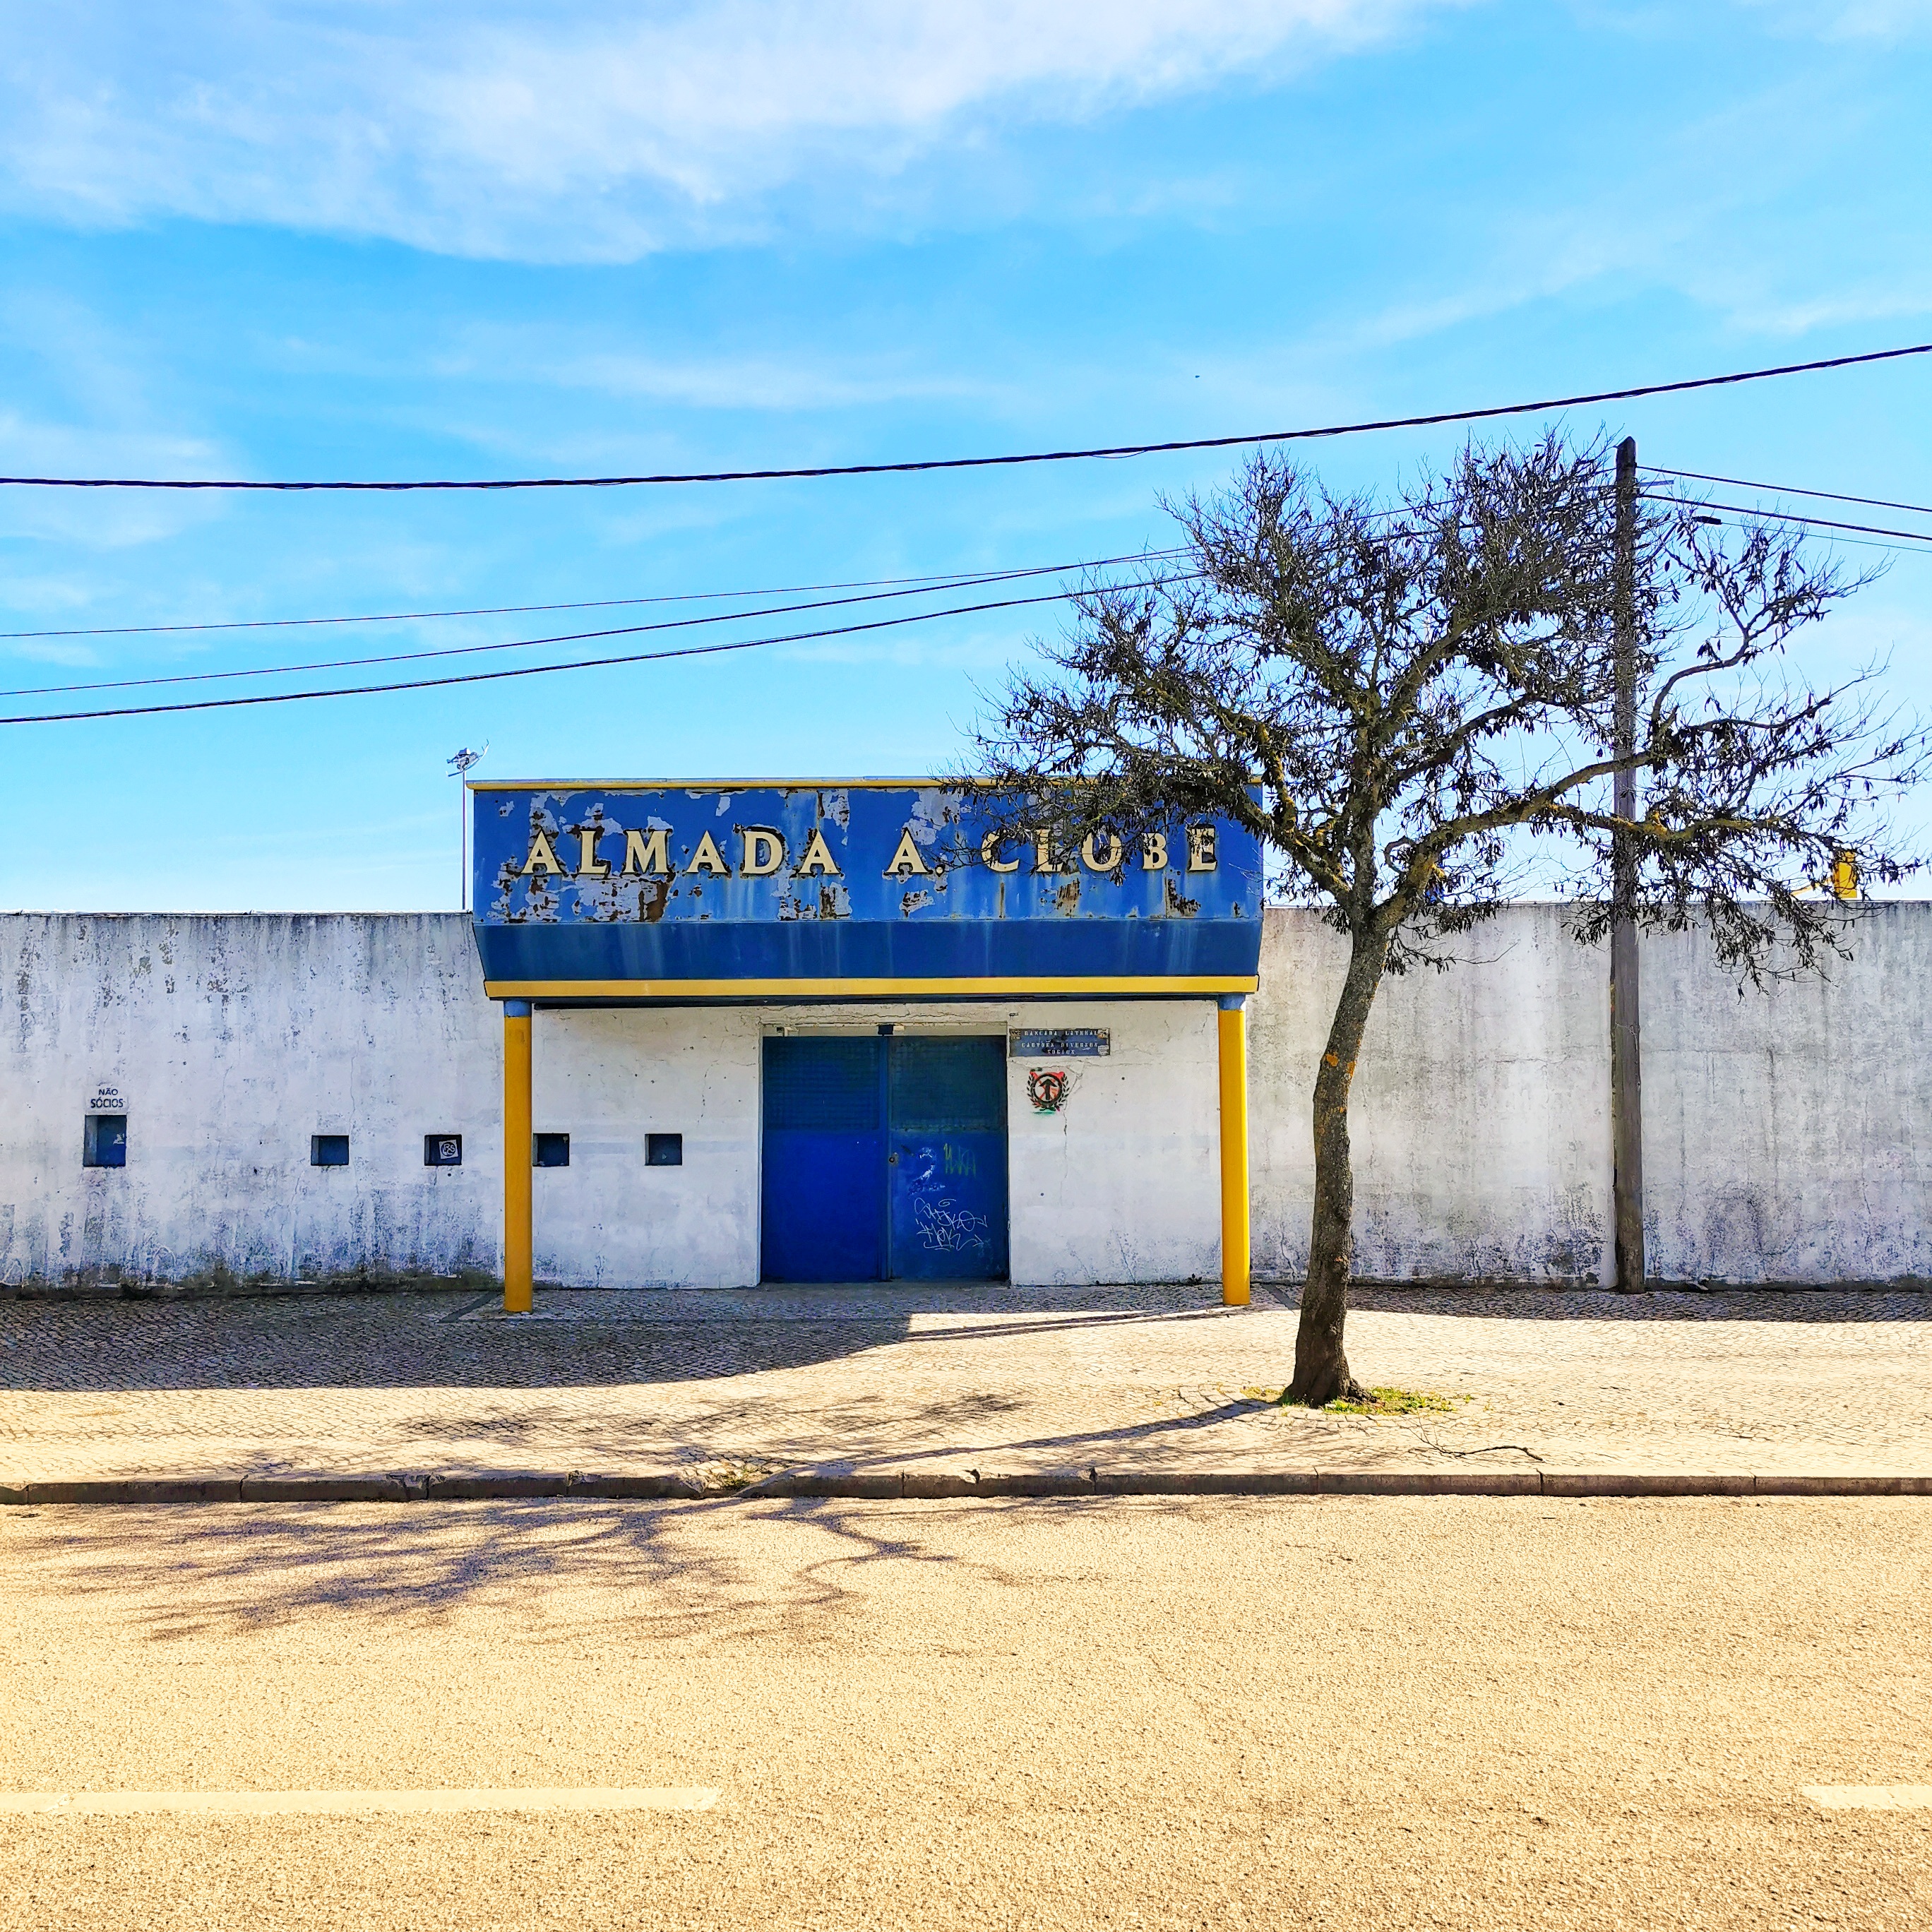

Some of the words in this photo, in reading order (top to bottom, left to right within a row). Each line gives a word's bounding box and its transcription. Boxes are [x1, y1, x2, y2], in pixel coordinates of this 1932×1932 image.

[521, 830, 840, 875] ALMADA
[885, 829, 944, 875] A.
[980, 828, 1218, 873] CLUBE
[98, 1087, 119, 1096] NÃO
[90, 1097, 124, 1109] SÓCIOS
